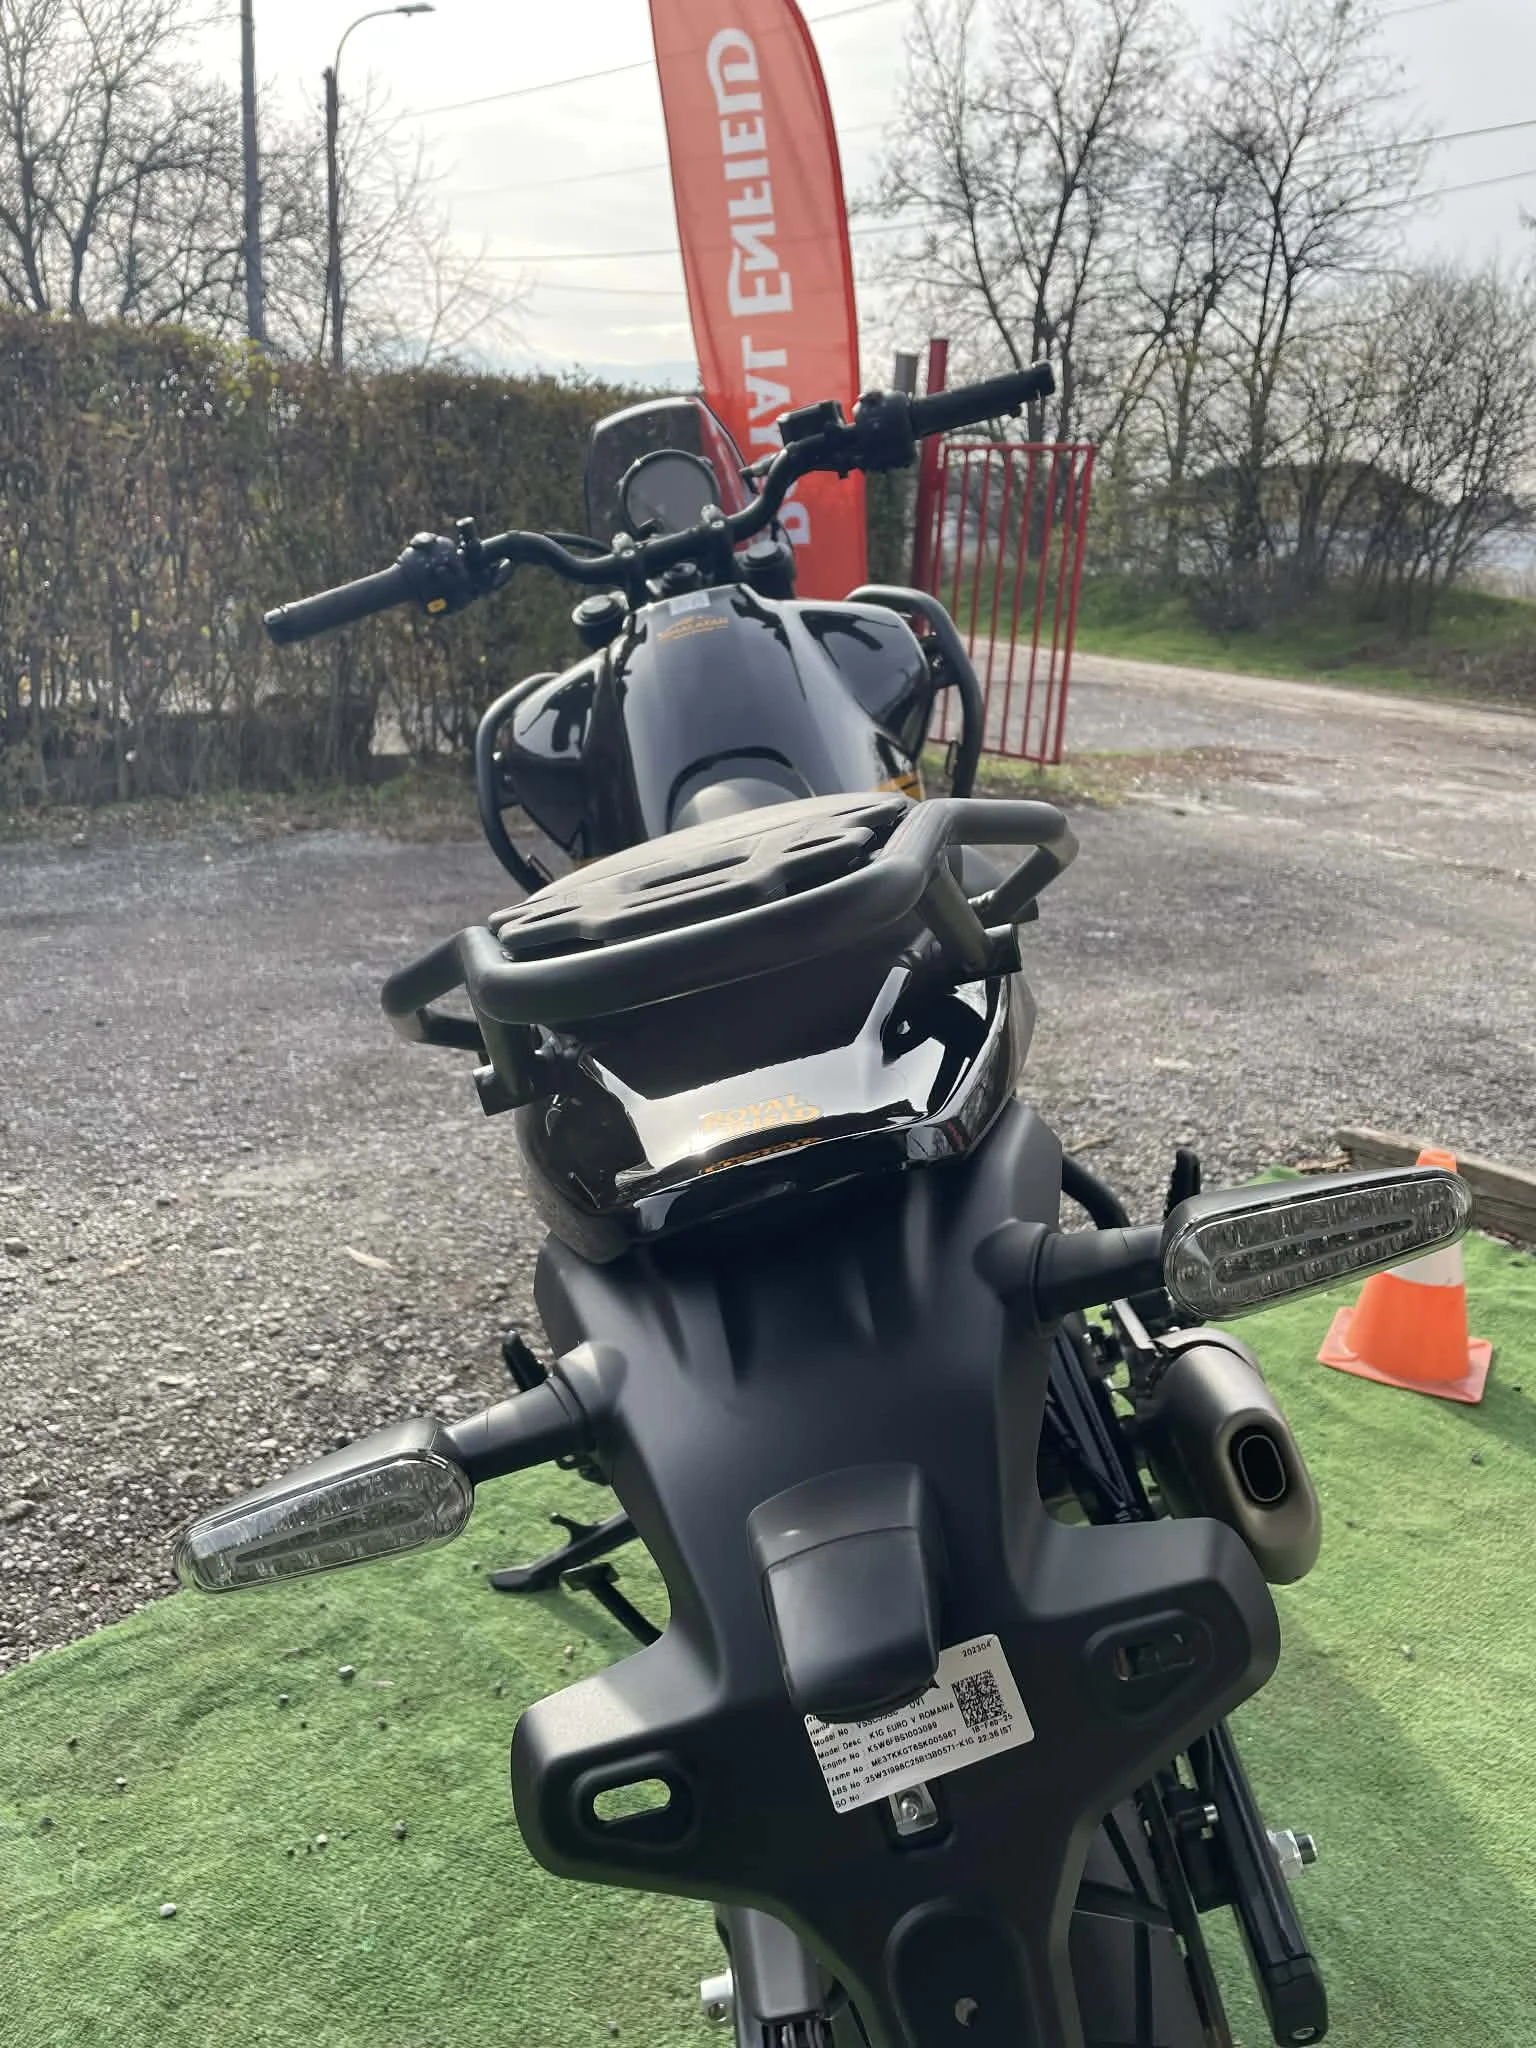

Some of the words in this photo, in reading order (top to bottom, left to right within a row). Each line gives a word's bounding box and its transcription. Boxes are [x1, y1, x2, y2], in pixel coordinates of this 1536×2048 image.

[813, 1734, 835, 1747] Model
[838, 1728, 849, 1737] No
[818, 1746, 840, 1759] Model
[886, 1720, 908, 1733] EURO
[919, 1702, 955, 1721] ROMANIA
[822, 1756, 847, 1771] Engine
[849, 1751, 860, 1760] No
[827, 1771, 850, 1784] Frame
[853, 1766, 864, 1774] No
[831, 1786, 848, 1797] ABS
[850, 1781, 861, 1789] No
[850, 1794, 860, 1802] No
